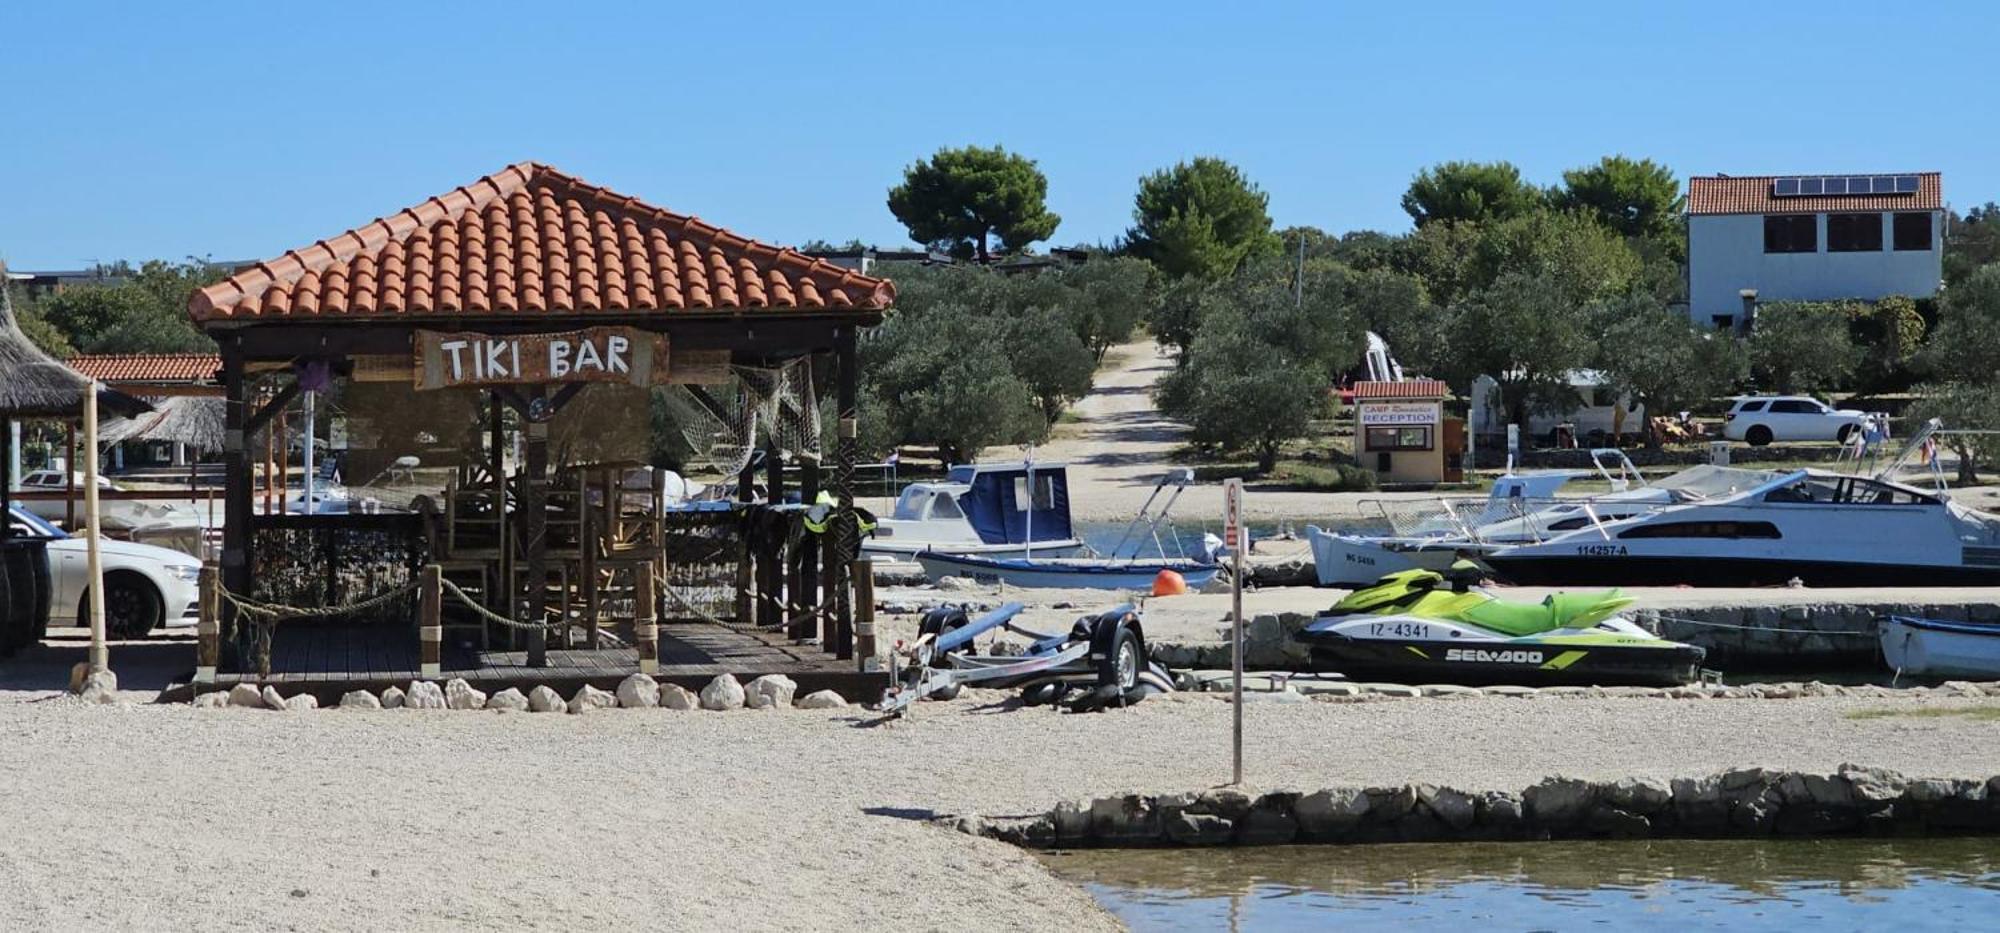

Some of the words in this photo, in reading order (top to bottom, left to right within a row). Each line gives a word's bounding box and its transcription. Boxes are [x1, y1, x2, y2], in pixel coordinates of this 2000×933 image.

[441, 339, 521, 381] TIKI
[549, 335, 630, 378] BAR
[1364, 405, 1389, 413] CAMP
[1363, 414, 1435, 422] RECEPTION
[1577, 545, 1628, 556] 114257-A
